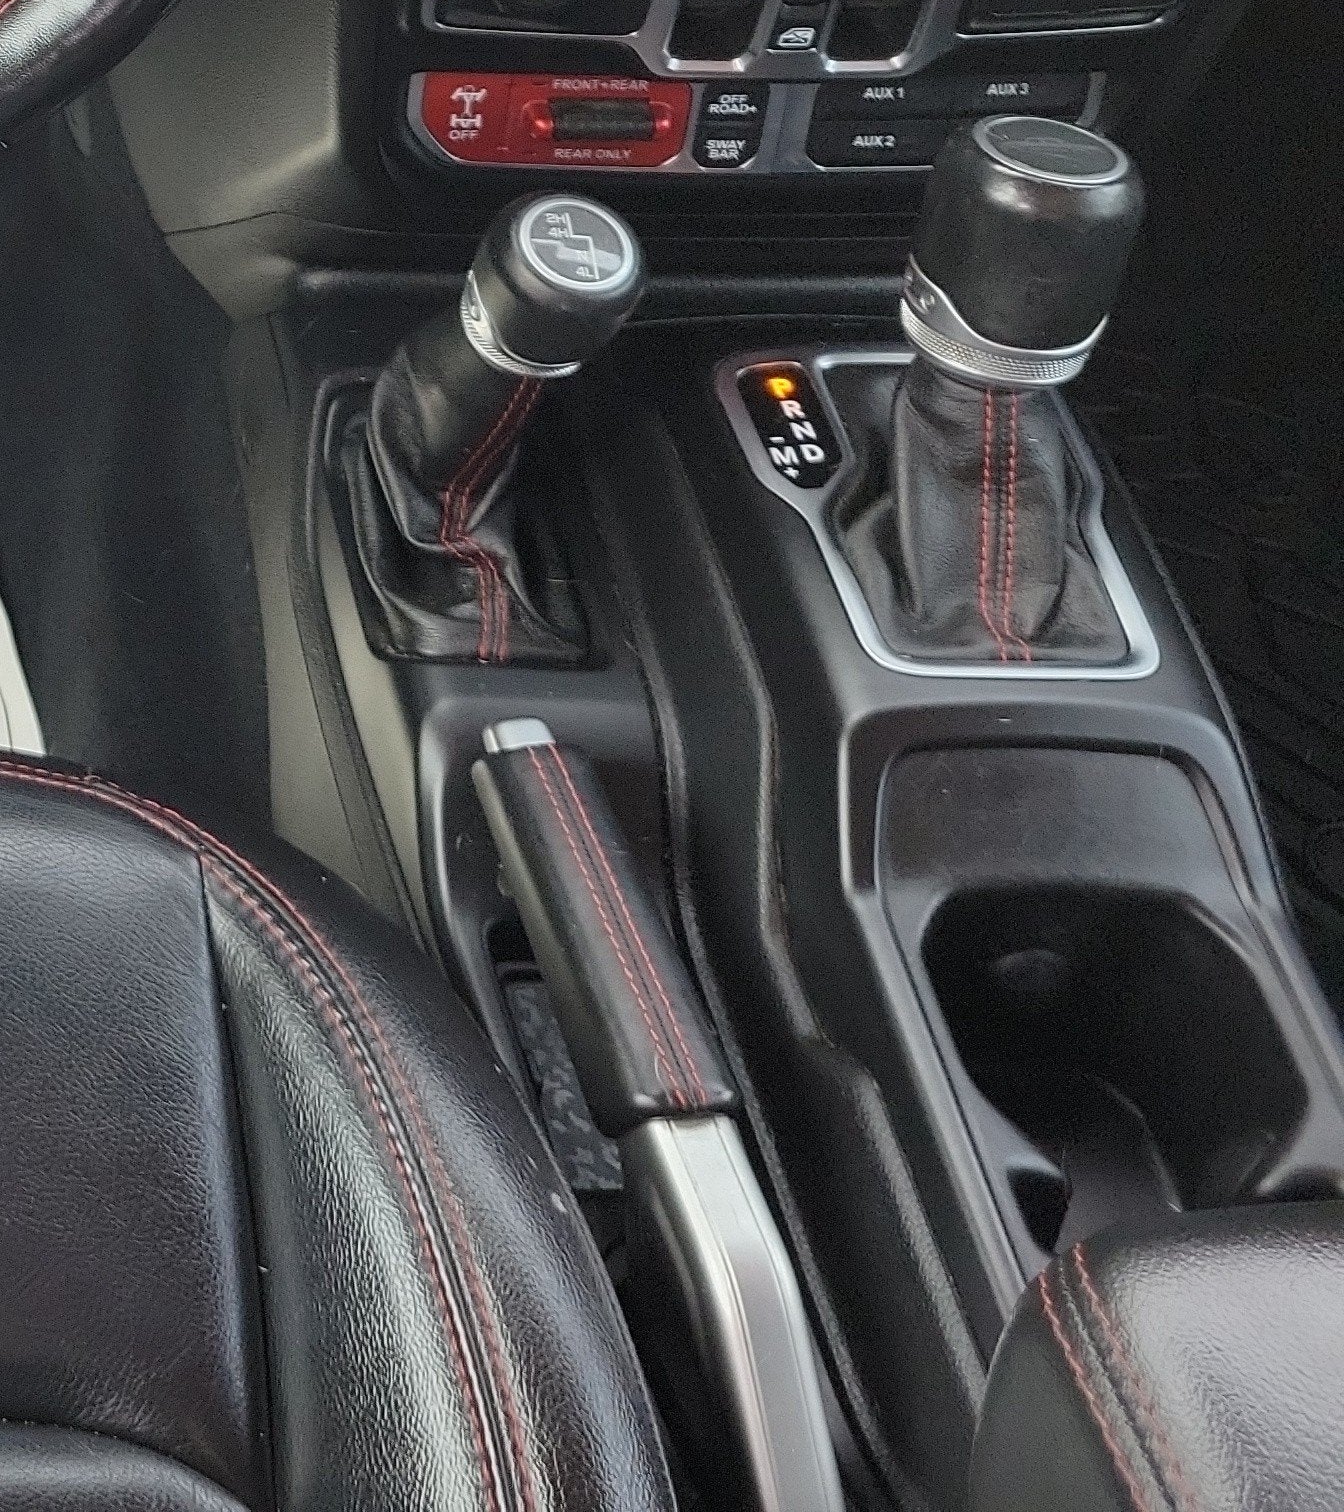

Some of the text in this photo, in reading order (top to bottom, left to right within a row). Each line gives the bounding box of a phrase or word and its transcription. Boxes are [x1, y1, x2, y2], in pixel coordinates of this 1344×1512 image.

[863, 87, 905, 101] AUX 1
[986, 83, 1031, 96] AUX 3
[720, 94, 748, 106] OFF
[449, 129, 479, 141] OFF
[852, 135, 895, 148] AUX 2
[706, 139, 746, 152] SWAY
[554, 148, 631, 161] REAR ONLY
[709, 148, 739, 160] BAR
[545, 212, 566, 224] 2H
[548, 227, 569, 238] 4H
[575, 266, 595, 277] 4L
[768, 377, 793, 399] P
[780, 400, 805, 420] R
[789, 420, 817, 441] N
[769, 445, 801, 467] M
[799, 444, 825, 464] D
